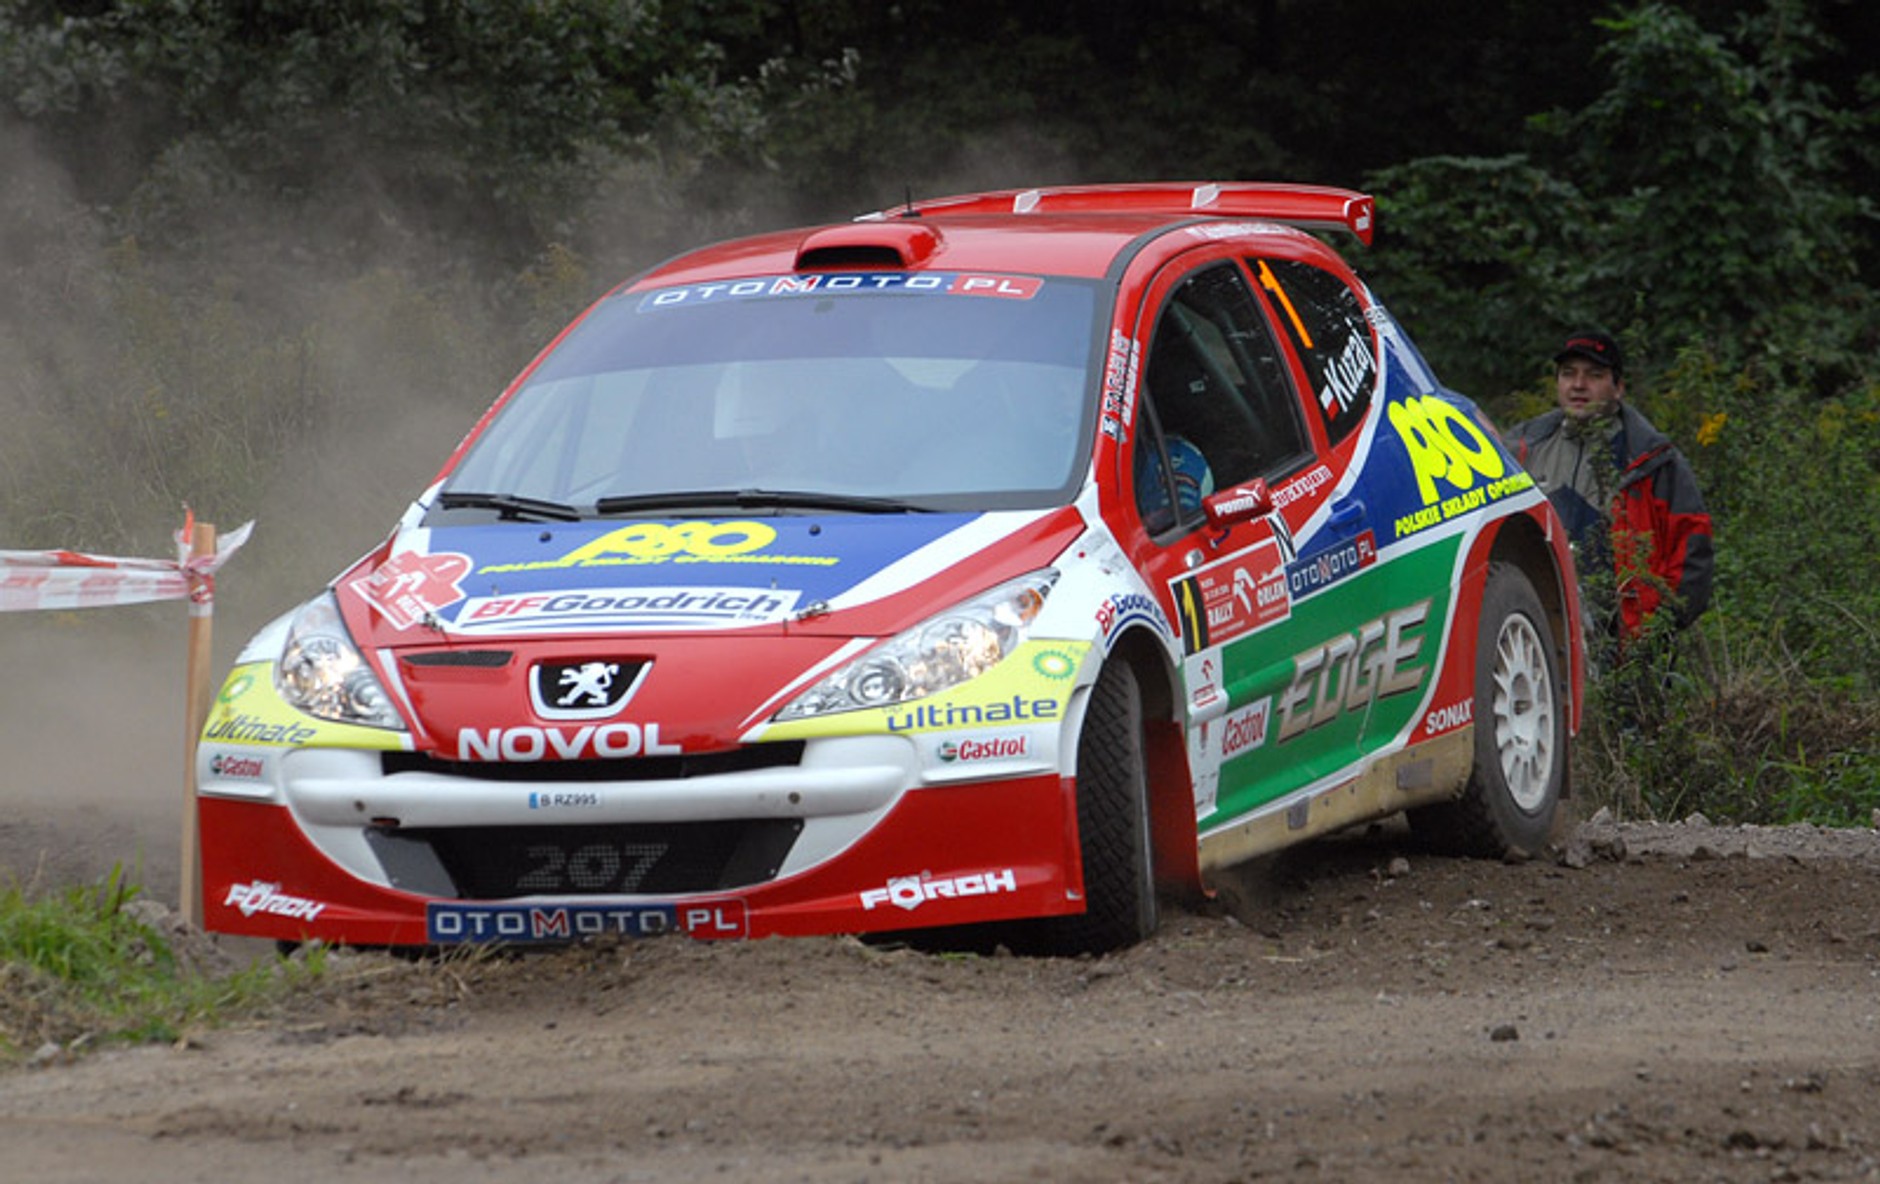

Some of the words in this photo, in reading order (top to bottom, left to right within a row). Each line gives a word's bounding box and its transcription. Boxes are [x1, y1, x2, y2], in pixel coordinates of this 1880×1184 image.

[652, 271, 1025, 306] OTOMOTO.PL
[469, 592, 784, 620] BFGoodrich
[1277, 598, 1433, 745] EDGE
[207, 715, 317, 744] ultimate
[888, 696, 1058, 731] ultimate
[1222, 702, 1268, 756] Castrol
[1425, 696, 1474, 735] SONAX
[458, 723, 681, 762] NOVOL
[959, 735, 1026, 760] Castrol
[516, 843, 668, 892] 207
